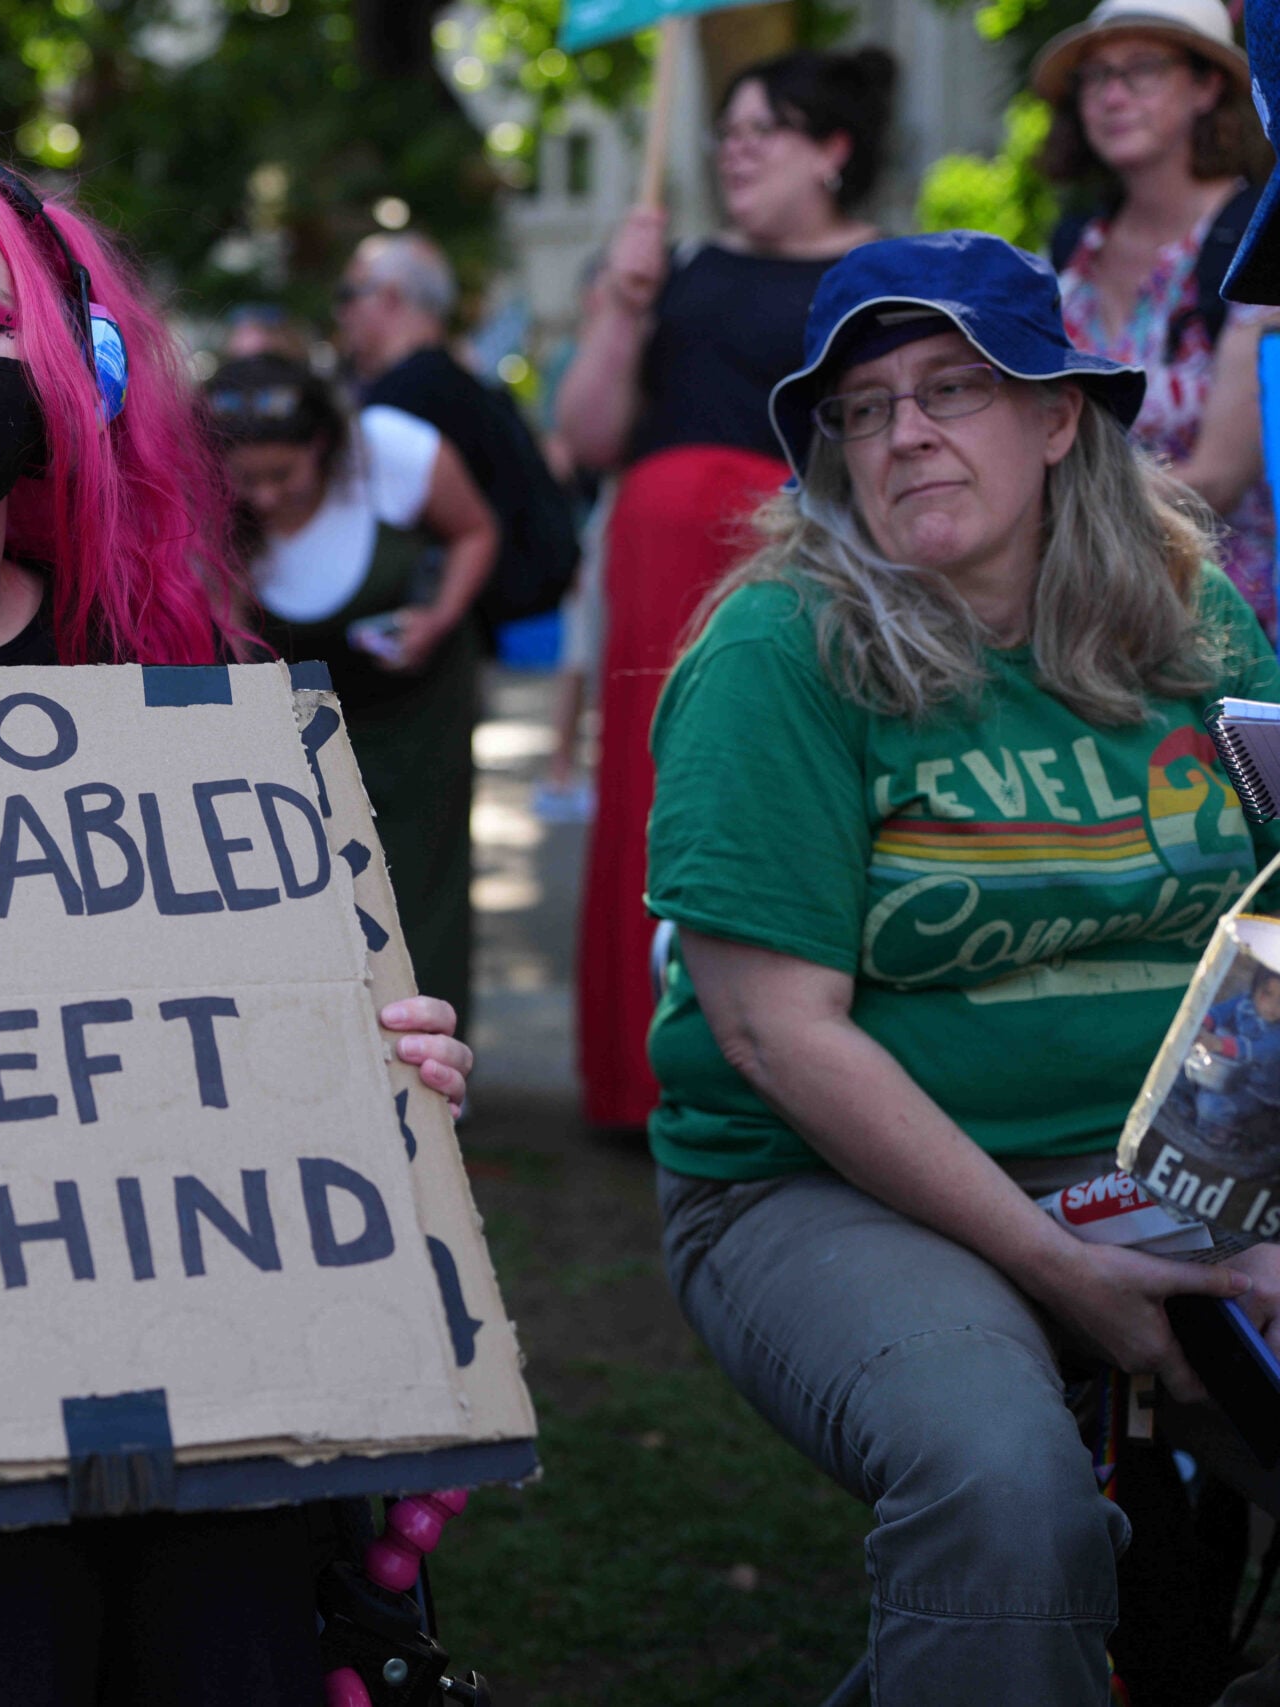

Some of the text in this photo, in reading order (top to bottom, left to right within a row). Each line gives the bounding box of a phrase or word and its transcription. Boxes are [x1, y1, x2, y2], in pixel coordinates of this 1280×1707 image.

[874, 736, 1142, 821] LEVEL
[862, 871, 1248, 984] Complet
[1146, 1144, 1236, 1220] End
